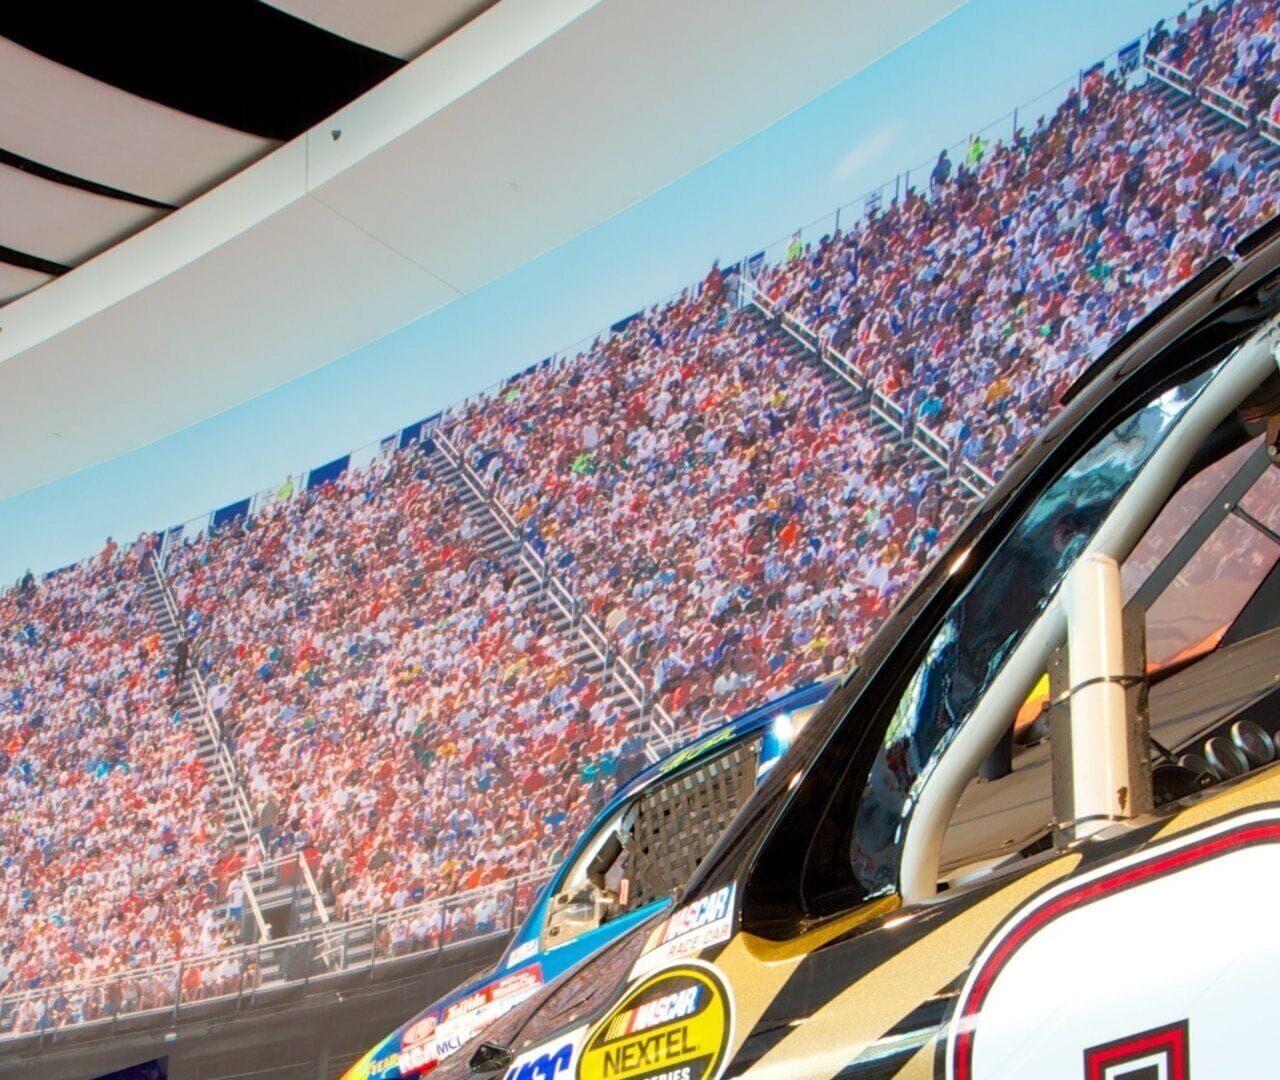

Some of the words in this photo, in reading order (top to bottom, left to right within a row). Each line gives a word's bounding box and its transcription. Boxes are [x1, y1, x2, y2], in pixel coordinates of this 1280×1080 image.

[666, 935, 701, 960] RACE
[703, 924, 730, 945] CAR
[629, 985, 704, 1034] NASCAR
[603, 1026, 696, 1078] NEXTEL
